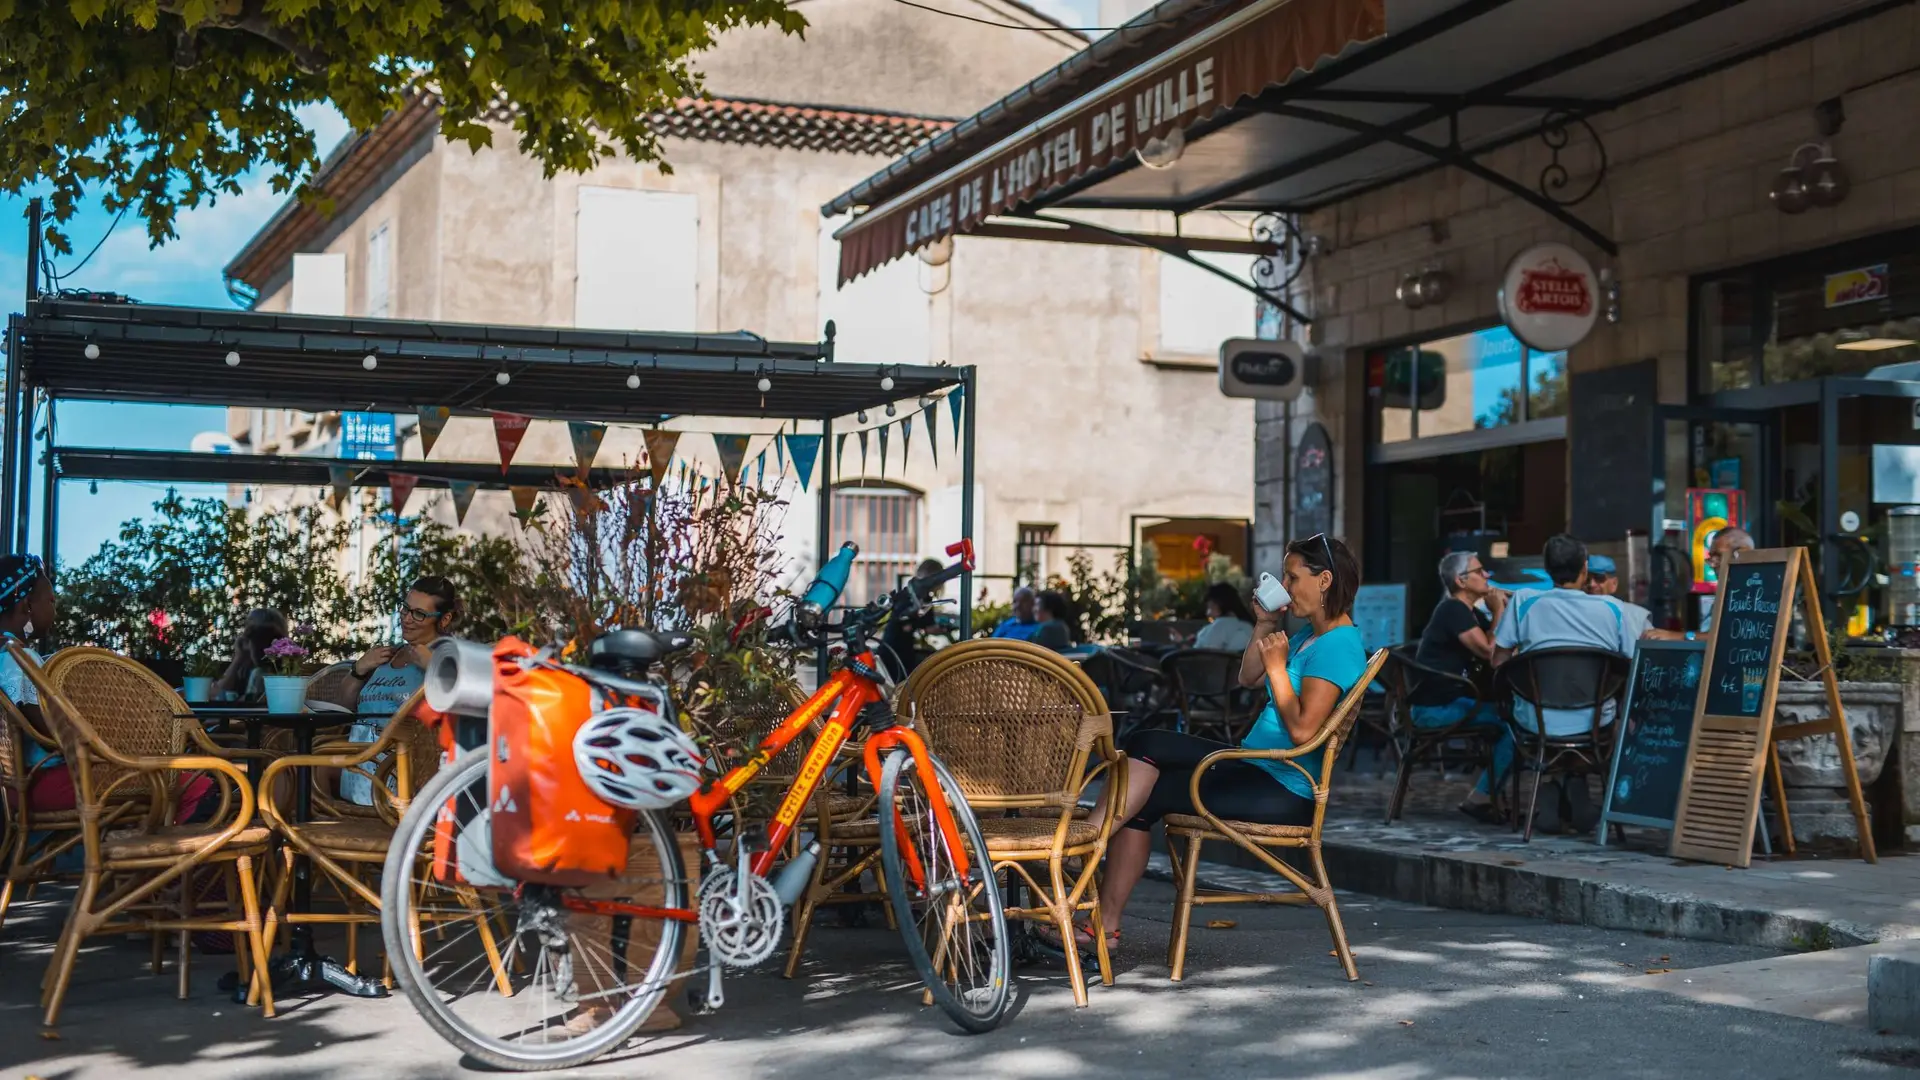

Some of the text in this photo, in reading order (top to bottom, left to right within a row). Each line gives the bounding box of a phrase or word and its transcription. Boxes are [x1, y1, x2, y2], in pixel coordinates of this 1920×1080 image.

[906, 192, 953, 246] CAFE
[958, 176, 984, 221] DE
[1091, 102, 1126, 157] DE
[1135, 56, 1214, 133] VILLE
[1532, 279, 1581, 293] STELLA
[1531, 292, 1582, 307] ARTOIS
[1730, 618, 1774, 640] ORANGE
[1728, 645, 1768, 665] CITRON
[366, 675, 406, 692] Hello
